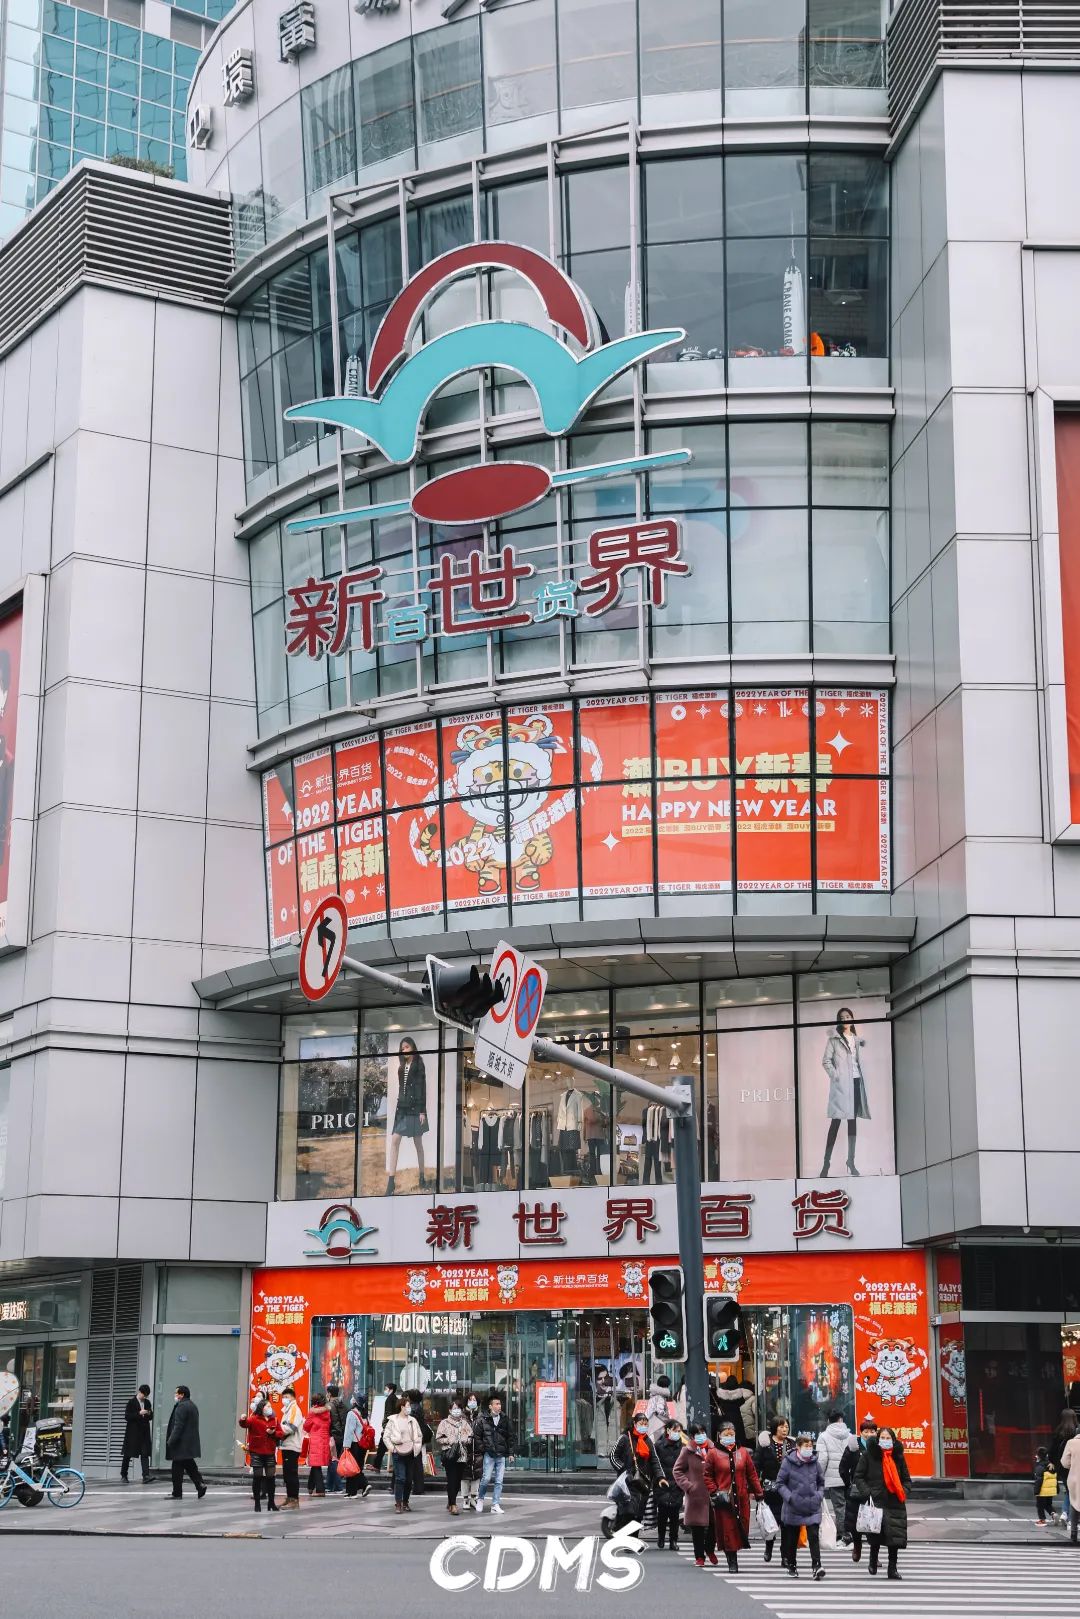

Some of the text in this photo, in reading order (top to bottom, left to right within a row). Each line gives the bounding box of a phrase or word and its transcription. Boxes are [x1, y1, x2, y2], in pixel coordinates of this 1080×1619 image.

[736, 690, 756, 698] 2022
[820, 690, 843, 698] TIGER
[586, 698, 606, 707] 2022
[606, 697, 627, 706] YEAR
[665, 693, 688, 701] TIGER
[879, 692, 887, 712] 2022
[448, 716, 466, 725] 2022
[465, 713, 484, 723] YEAR
[484, 712, 495, 720] OF
[518, 705, 538, 715] TIGER
[879, 712, 887, 735] YEAR
[394, 727, 412, 736] TIGER
[354, 737, 369, 747] YEAR
[880, 736, 887, 747] OF
[297, 800, 330, 831] 2022
[332, 787, 388, 818] YEAR
[621, 798, 838, 821] HAPPY NEW YEAR
[277, 817, 391, 867] OF THE TIGER
[880, 834, 888, 853] 2022
[609, 886, 631, 894] YEAR
[668, 883, 691, 891] TIGER
[820, 881, 844, 889] TIGER
[471, 897, 491, 907] YEAR
[491, 896, 501, 904] OF
[522, 892, 544, 901] TIGER
[401, 907, 418, 916] TIGER
[310, 1111, 371, 1130] PRICH
[425, 1189, 853, 1250] 新世界百货
[441, 1267, 489, 1279] 2022 YEAR
[429, 1278, 490, 1289] OF THE TIGER
[552, 1273, 609, 1285] 新世界百货
[865, 1282, 917, 1292] 2022 YEAR
[283, 1295, 305, 1303] YEAR
[853, 1292, 918, 1301] OF THE TIGER
[253, 1303, 305, 1313] OF THE TIGER
[905, 1441, 926, 1449] YEAR
